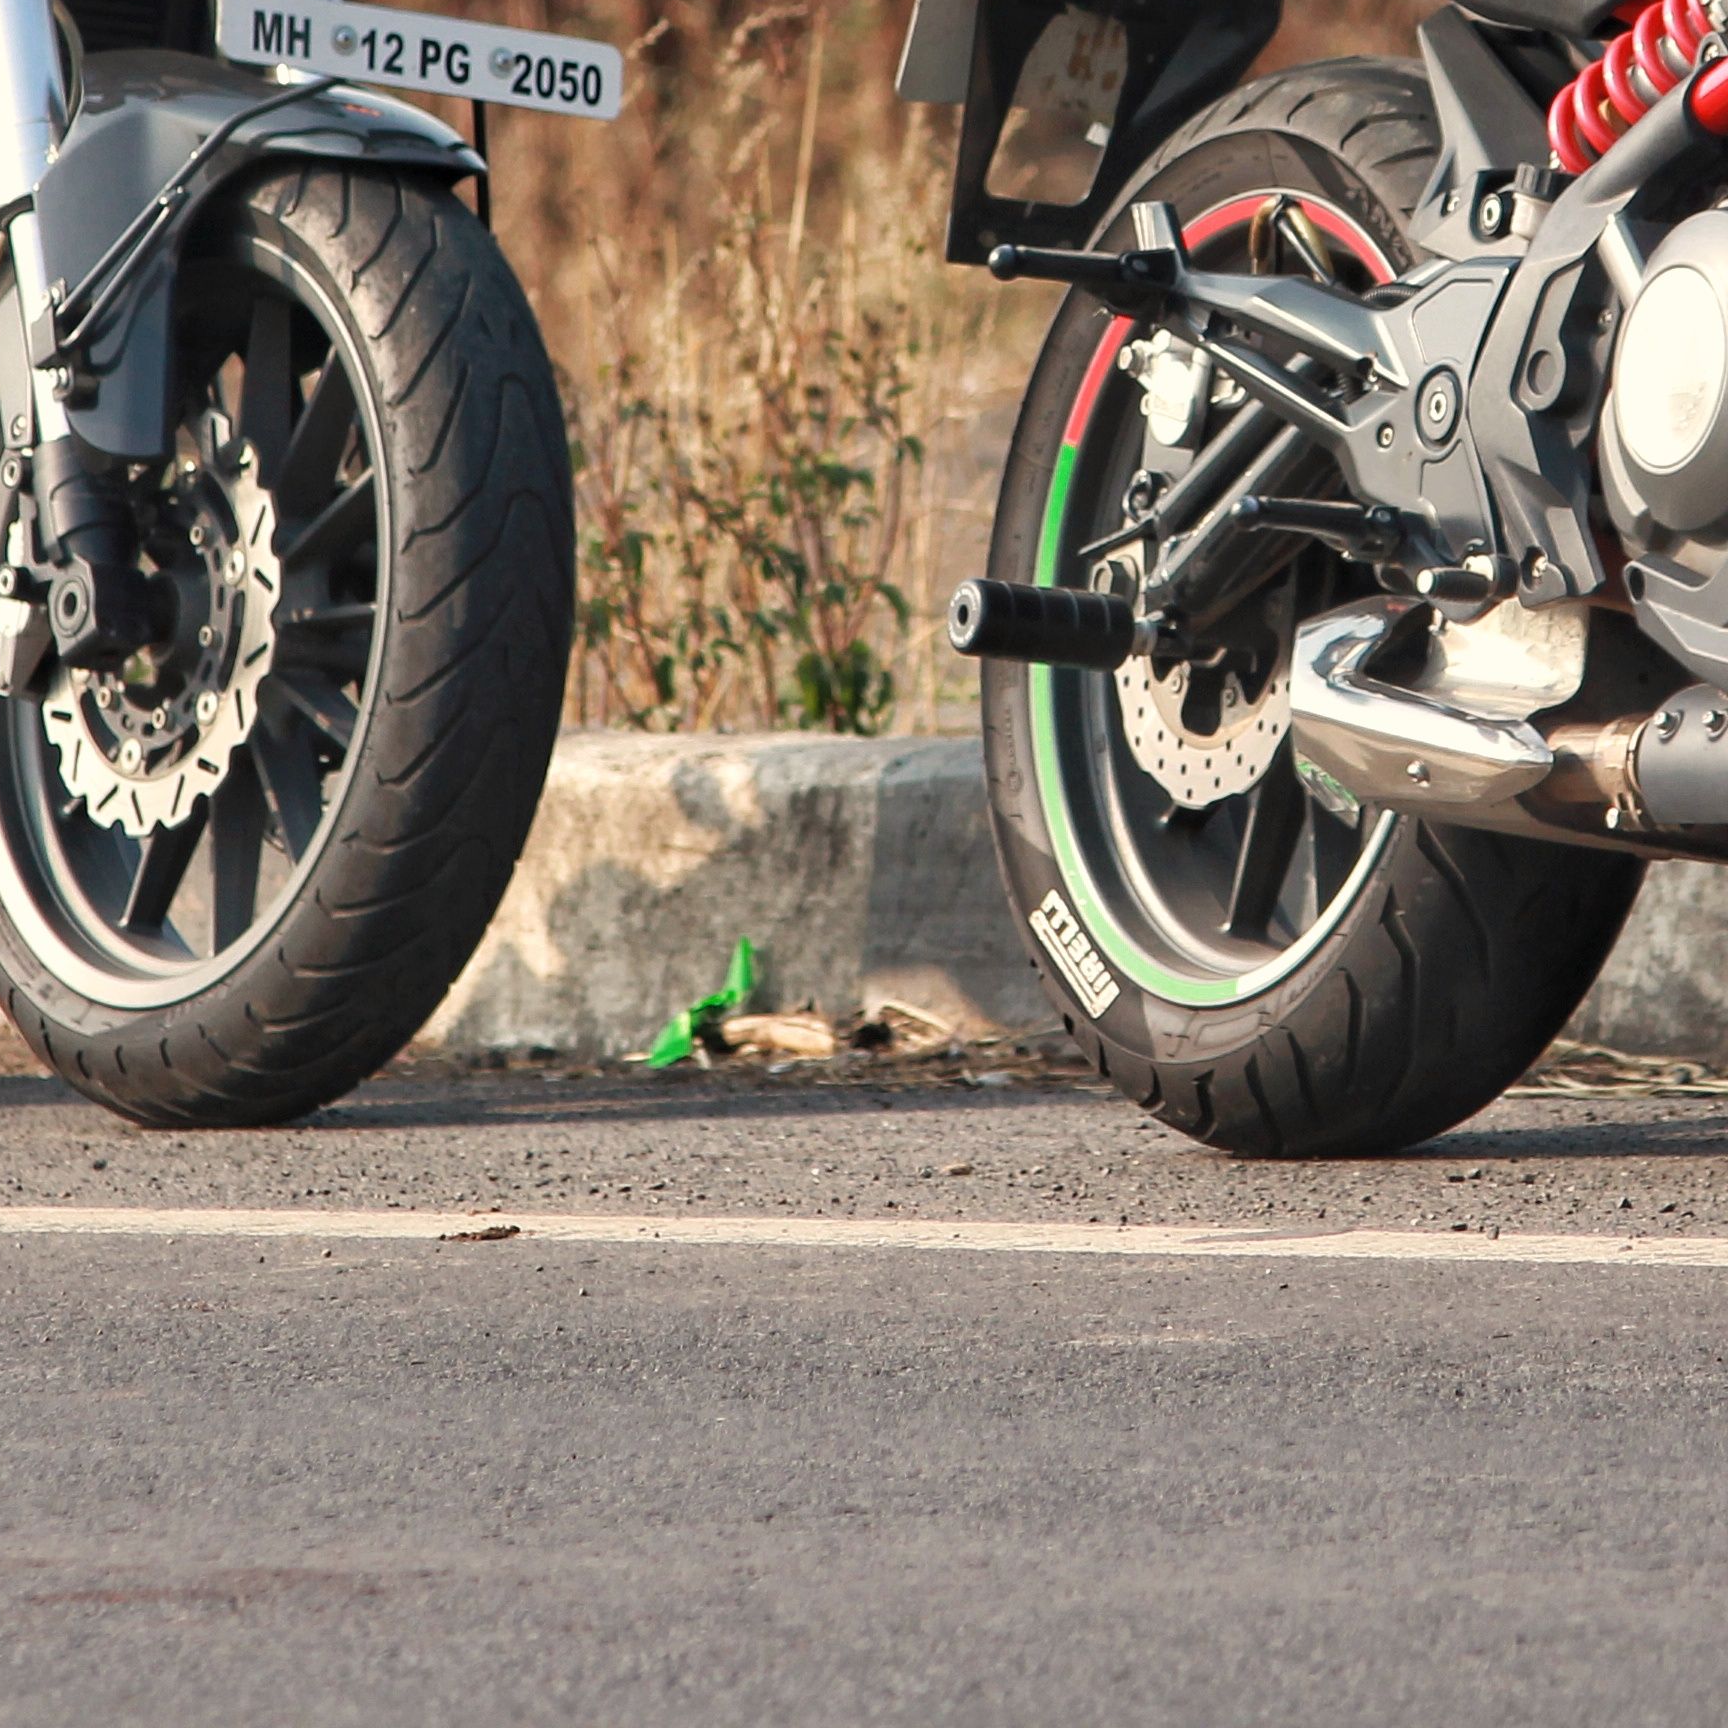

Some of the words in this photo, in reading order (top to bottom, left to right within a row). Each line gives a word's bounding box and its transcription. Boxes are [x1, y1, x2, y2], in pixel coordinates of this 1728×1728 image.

[252, 10, 312, 58] MH
[360, 28, 404, 75] 12
[419, 38, 471, 84] PG
[511, 52, 603, 106] 2050
[1028, 888, 1121, 1019] PIRELLI
